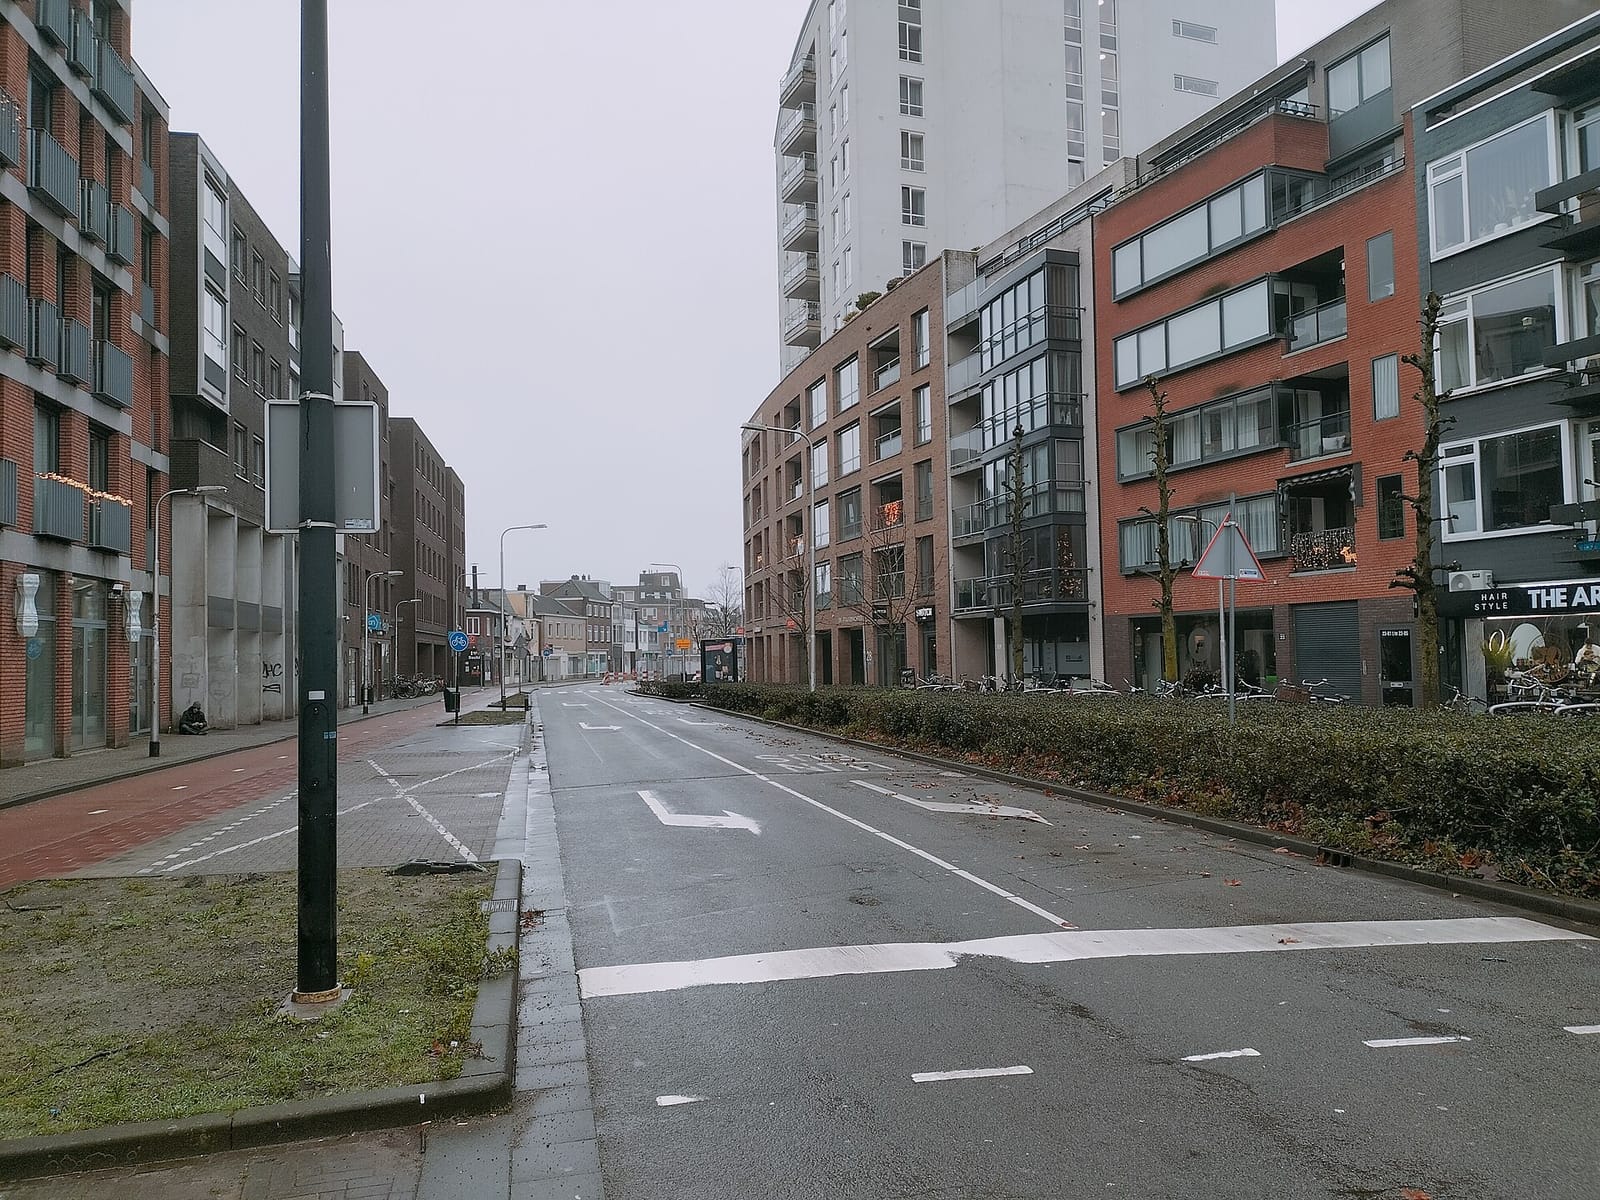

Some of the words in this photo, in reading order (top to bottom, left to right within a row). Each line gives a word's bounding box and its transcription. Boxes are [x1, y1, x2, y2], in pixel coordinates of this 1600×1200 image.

[1481, 592, 1507, 601] HAIR
[1528, 588, 1567, 608] THE
[1571, 586, 1600, 606] AR
[1475, 602, 1508, 610] STYLE
